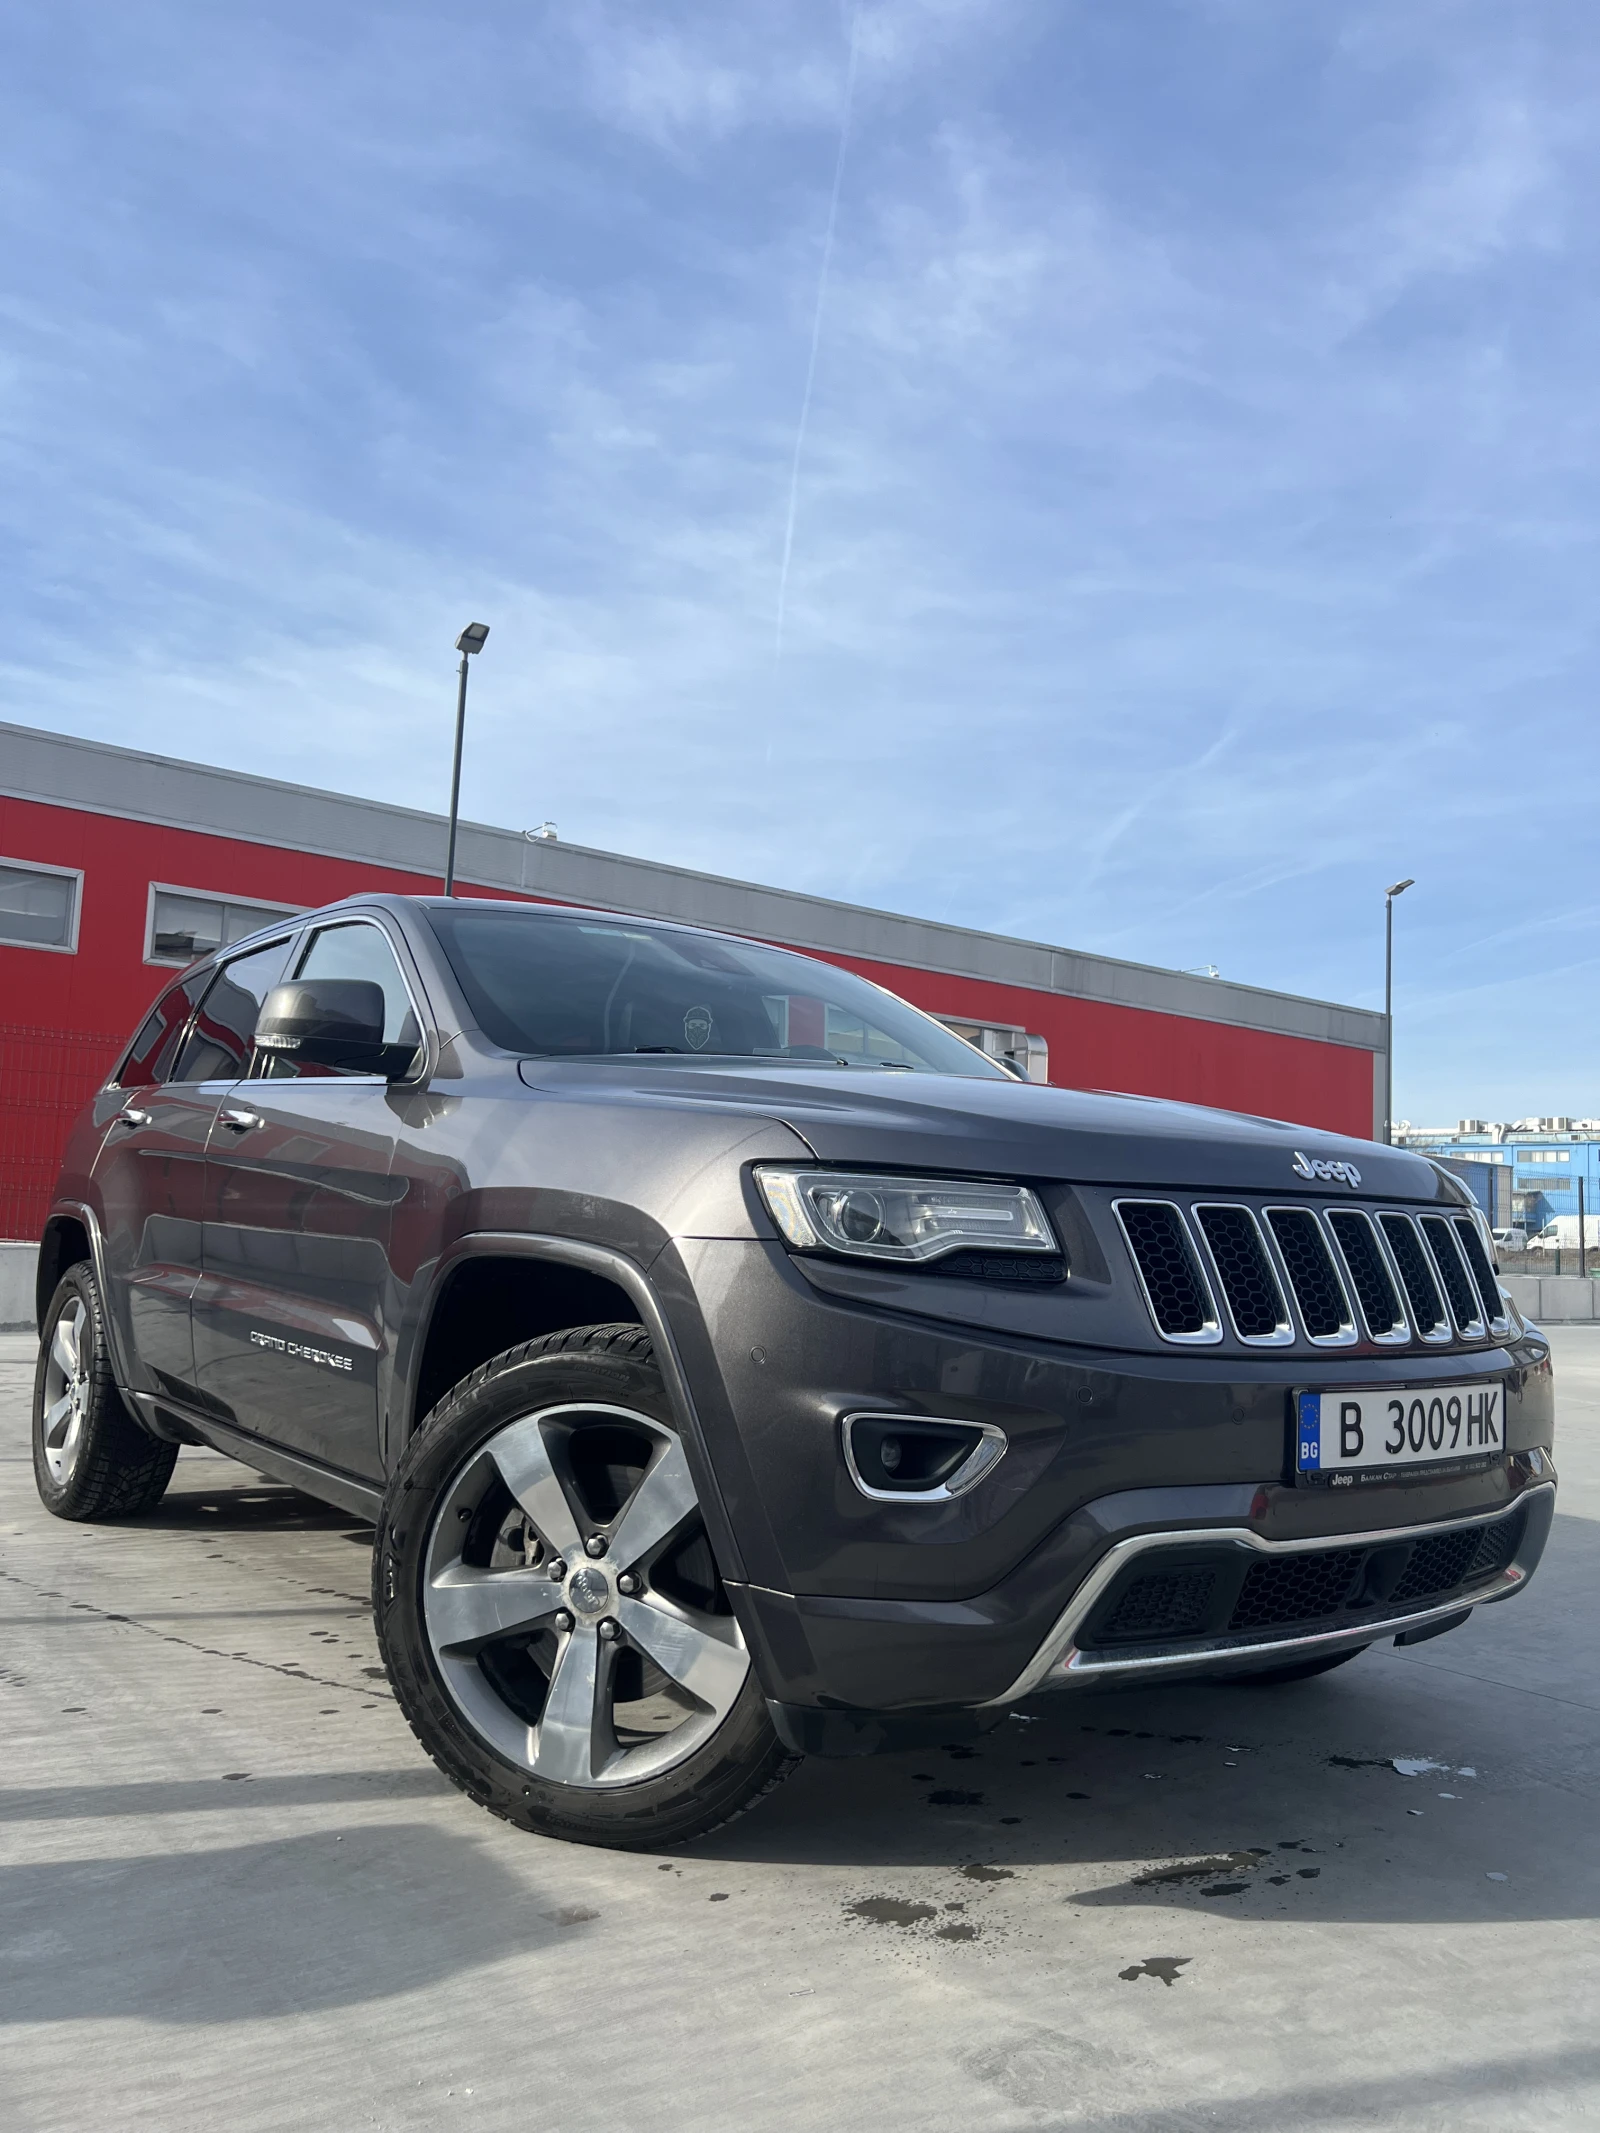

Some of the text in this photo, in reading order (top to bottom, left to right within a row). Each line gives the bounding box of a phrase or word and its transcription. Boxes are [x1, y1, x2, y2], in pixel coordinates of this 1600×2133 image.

[1292, 1151, 1361, 1188] Jeep
[287, 1342, 352, 1371] CHEROKEE
[1301, 1441, 1318, 1459] BG
[1332, 1473, 1353, 1487] Jeep
